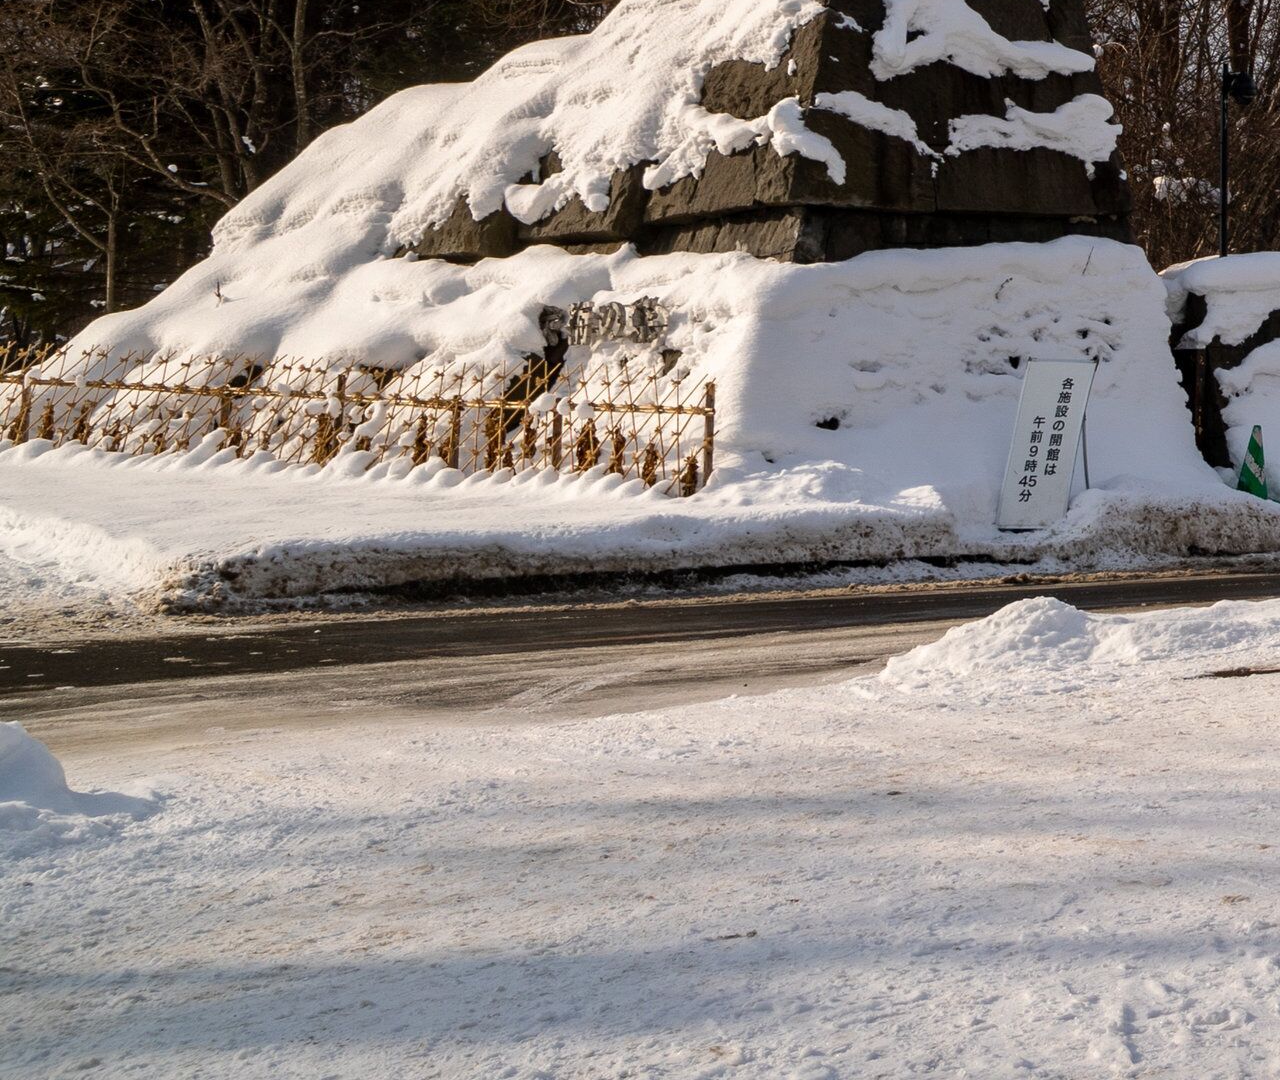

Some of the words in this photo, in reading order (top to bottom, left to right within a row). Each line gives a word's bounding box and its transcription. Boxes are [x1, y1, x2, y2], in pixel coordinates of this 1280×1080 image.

[1018, 415, 1046, 503] 午前9時45分
[1043, 377, 1075, 476] 各施設の開館は
